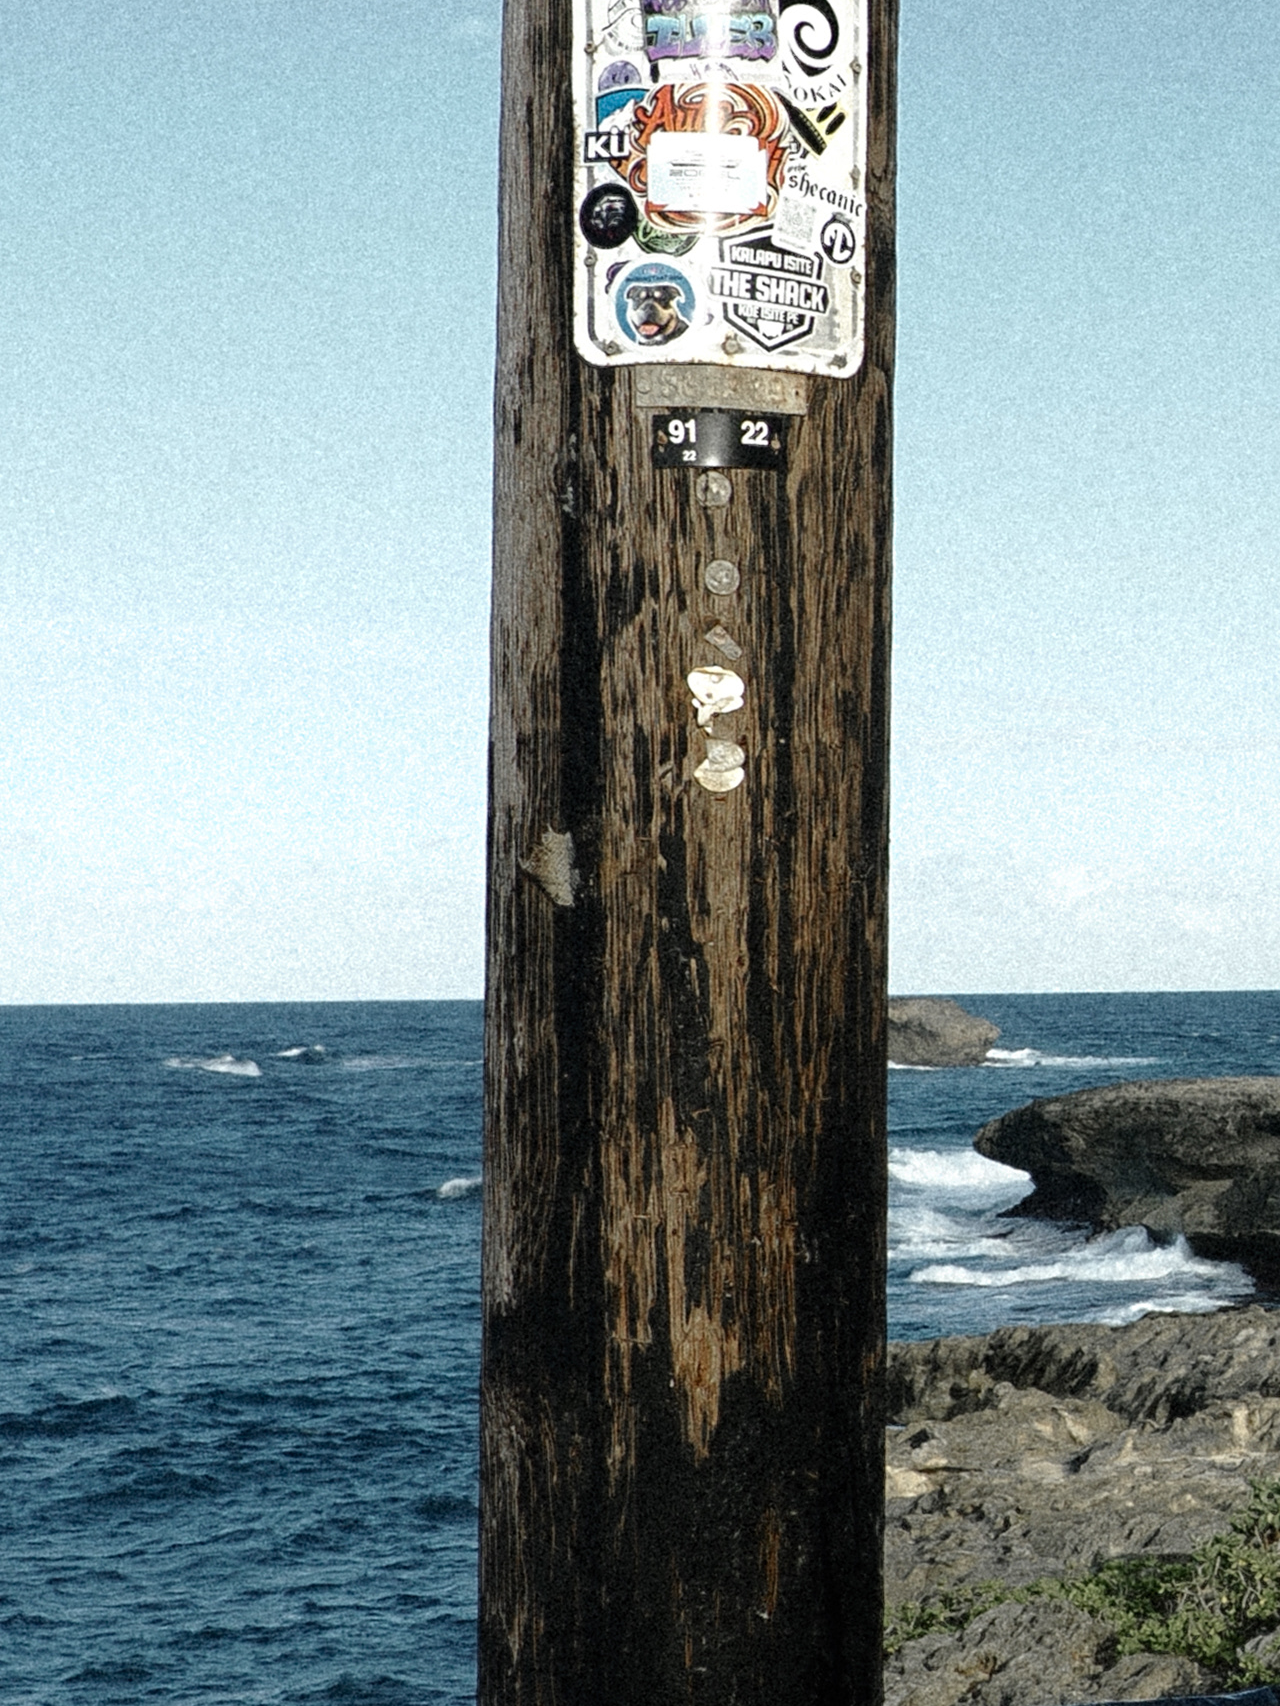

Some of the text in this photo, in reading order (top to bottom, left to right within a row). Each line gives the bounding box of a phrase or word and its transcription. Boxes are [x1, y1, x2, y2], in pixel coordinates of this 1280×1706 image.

[711, 269, 826, 312] THE SHACK
[667, 418, 769, 446] 91 22
[682, 450, 697, 462] 22
